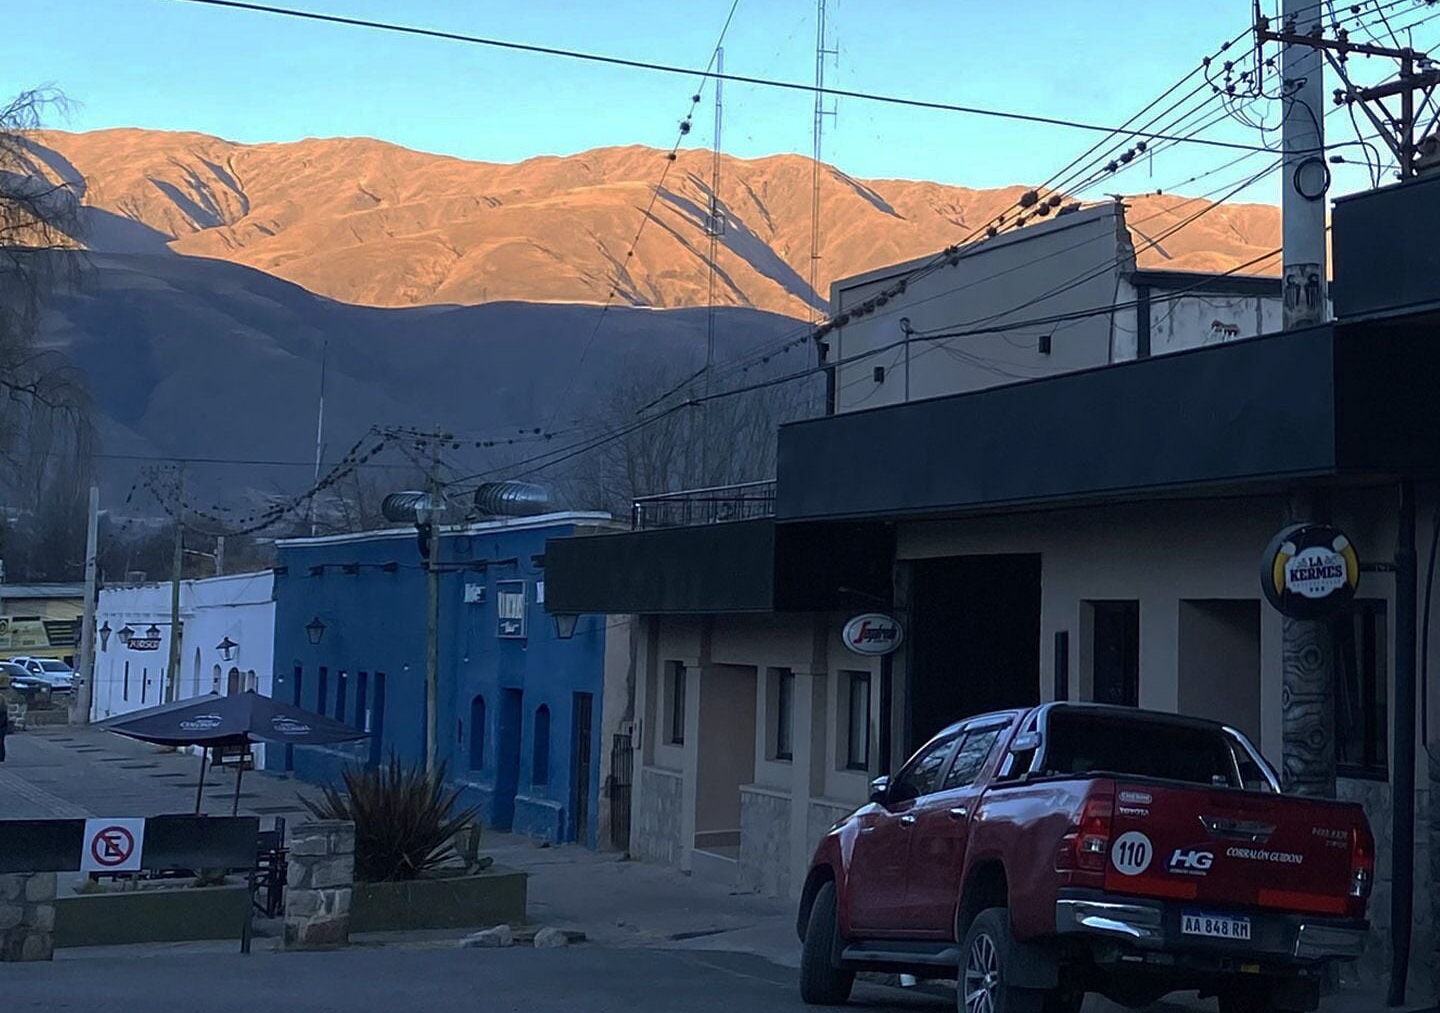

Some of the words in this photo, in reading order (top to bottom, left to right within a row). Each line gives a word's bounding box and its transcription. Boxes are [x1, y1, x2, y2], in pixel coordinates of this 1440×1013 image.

[1309, 555, 1323, 567] LA
[1290, 565, 1343, 582] KERMES
[1119, 806, 1150, 817] TOYOTA
[1119, 841, 1145, 868] 110
[1169, 848, 1215, 869] HG
[1185, 917, 1201, 933] AA
[1205, 919, 1229, 936] 848
